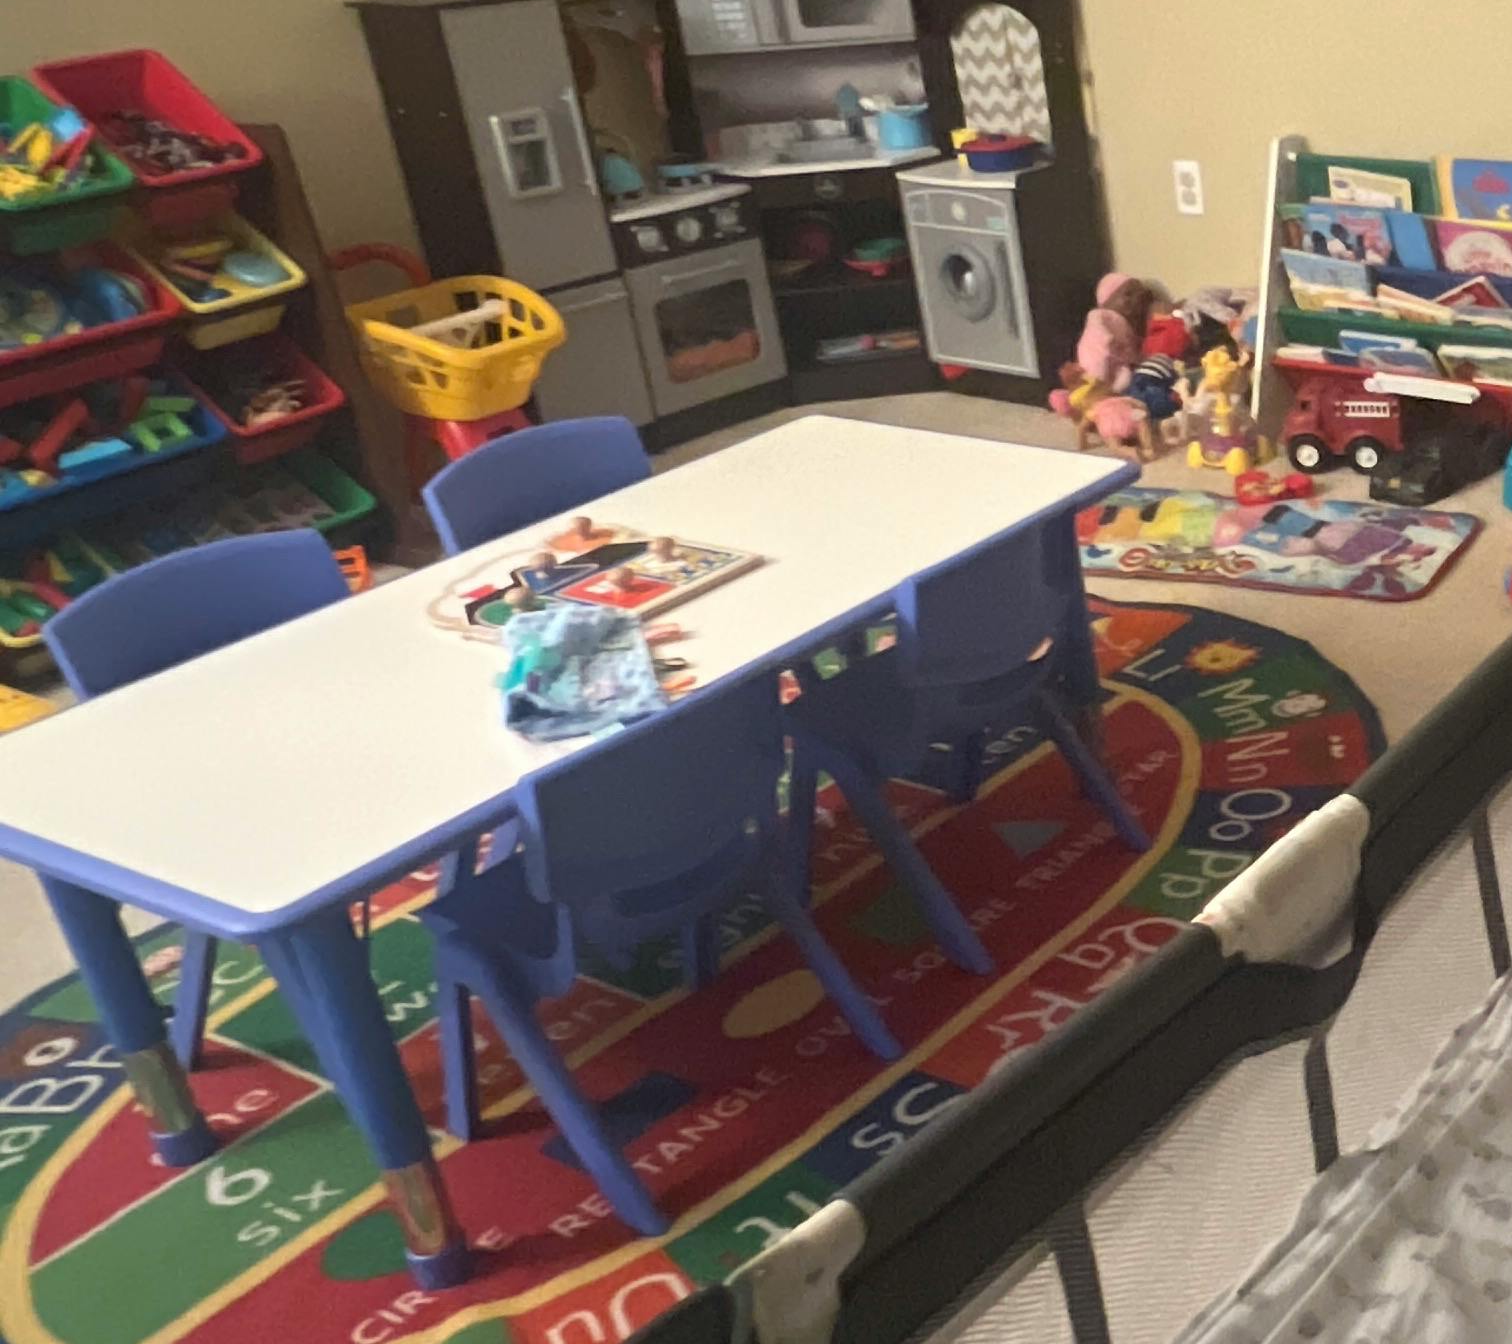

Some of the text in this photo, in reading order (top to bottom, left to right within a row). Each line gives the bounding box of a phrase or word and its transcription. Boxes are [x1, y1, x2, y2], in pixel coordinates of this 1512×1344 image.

[1197, 678, 1272, 736] Mm
[1225, 731, 1291, 784] Nn
[1208, 788, 1293, 842] Oo
[1159, 848, 1253, 899] Pp
[549, 1066, 791, 1239] RETANGLE
[795, 994, 893, 1057] OVL
[205, 1166, 273, 1207] 6
[236, 1179, 346, 1248] six
